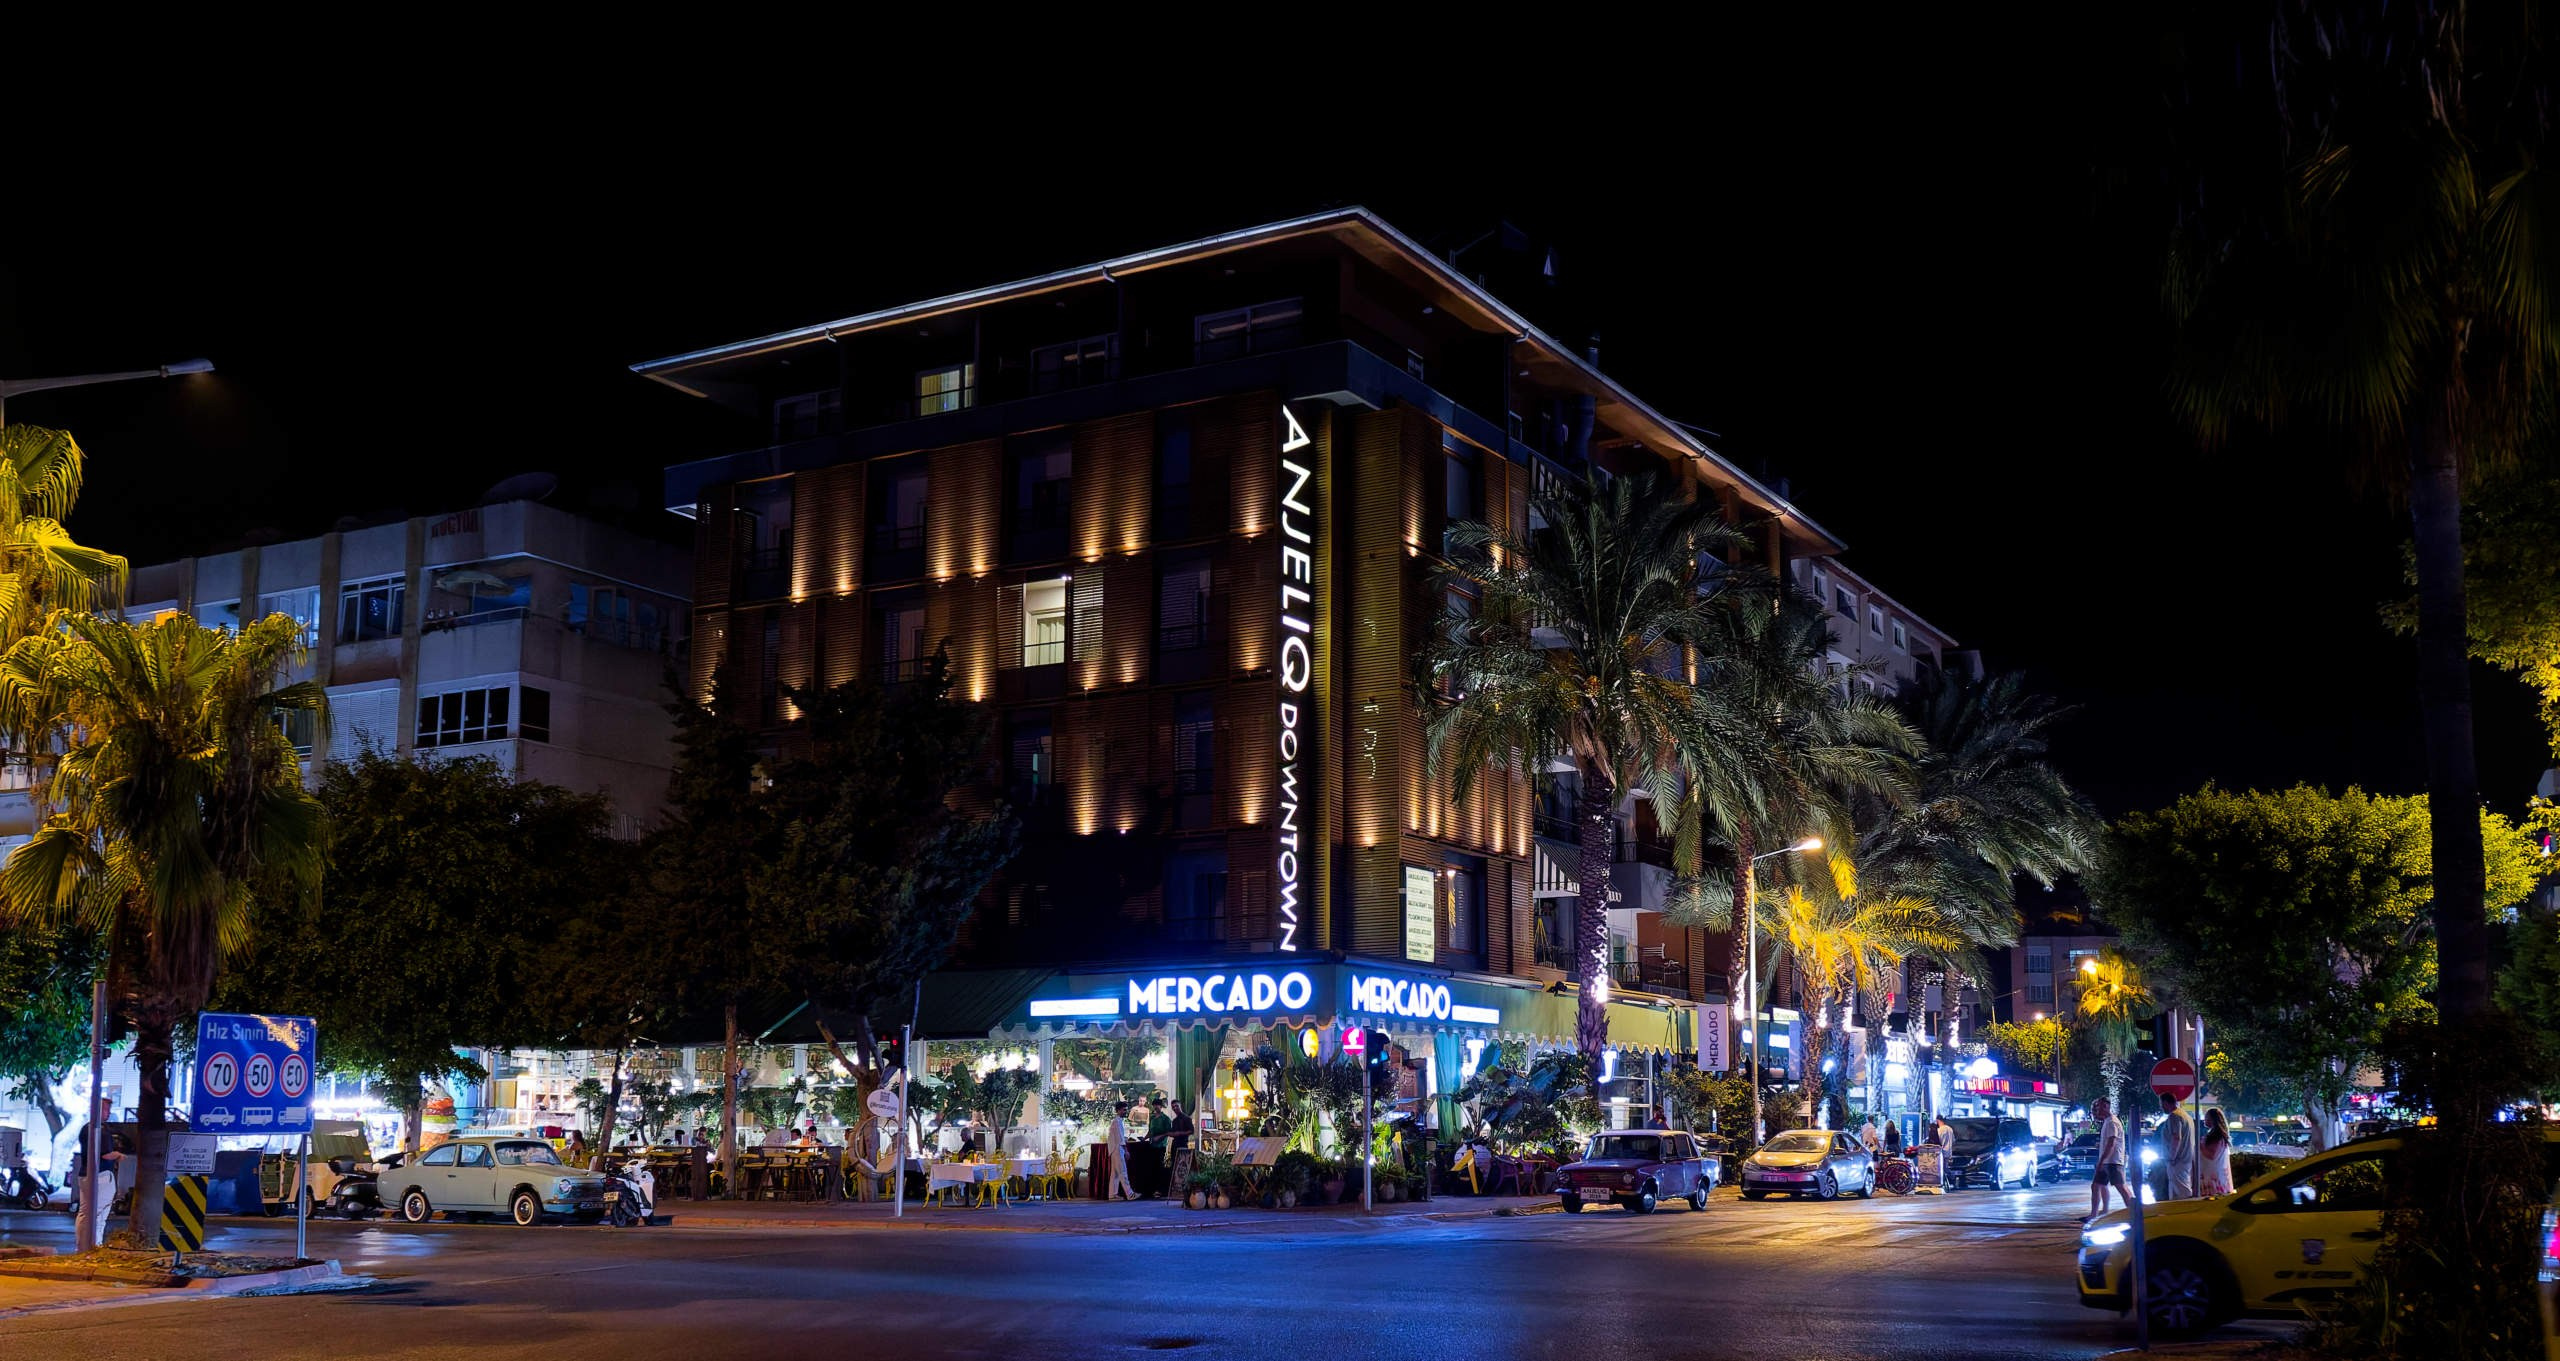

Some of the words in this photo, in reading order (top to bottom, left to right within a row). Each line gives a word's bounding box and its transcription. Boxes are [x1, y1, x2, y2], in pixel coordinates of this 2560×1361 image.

[1281, 404, 1311, 692] ANJELIQ
[1279, 702, 1298, 951] DOWNTOWN
[1129, 972, 1312, 1014] MERCADO
[1352, 974, 1451, 1020] MERCADO
[206, 1022, 229, 1040] Hız
[1708, 1010, 1719, 1067] MERCADO
[213, 1063, 232, 1086] 70
[251, 1064, 269, 1087] 50
[286, 1065, 303, 1087] 50
